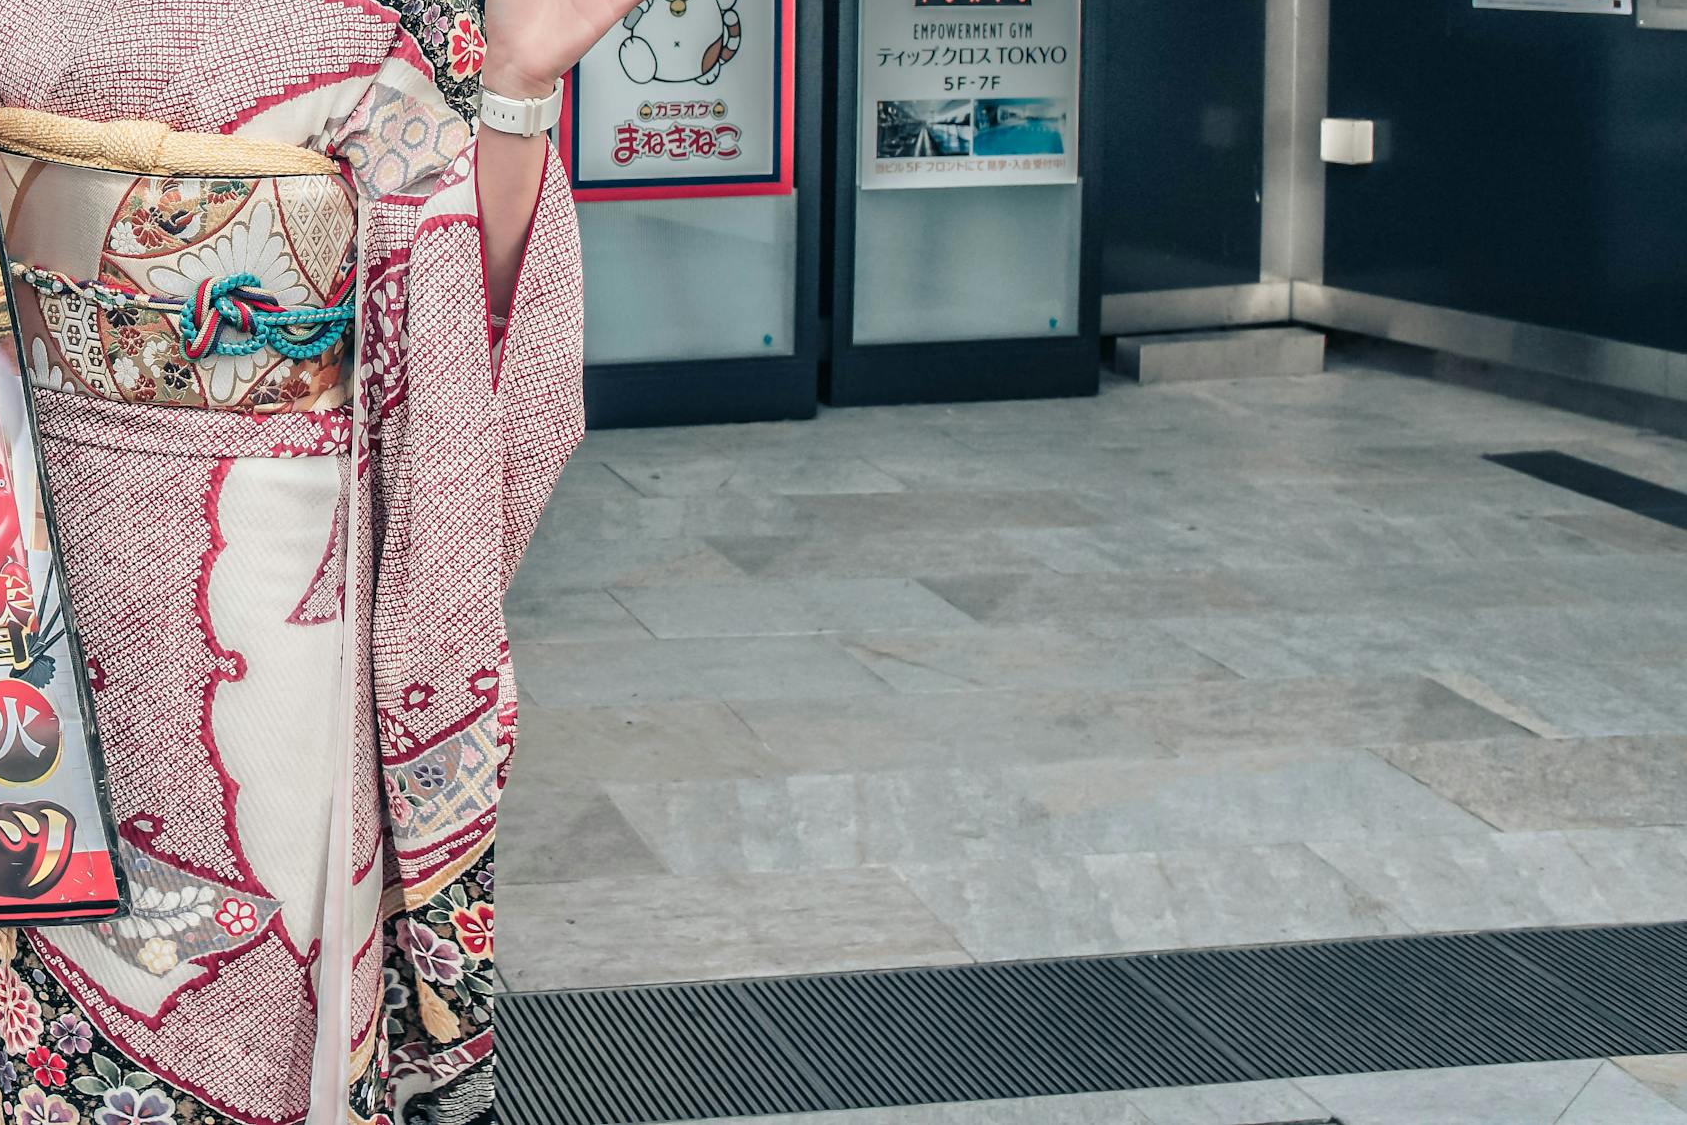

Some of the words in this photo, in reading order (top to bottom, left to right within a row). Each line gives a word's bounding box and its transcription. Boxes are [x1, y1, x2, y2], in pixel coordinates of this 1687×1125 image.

[913, 23, 1004, 40] EMPOWERMENT
[1008, 22, 1034, 39] GYM
[996, 45, 1068, 65] TOKYO
[655, 103, 710, 118] カラオケ
[613, 123, 740, 165] まねきねこ
